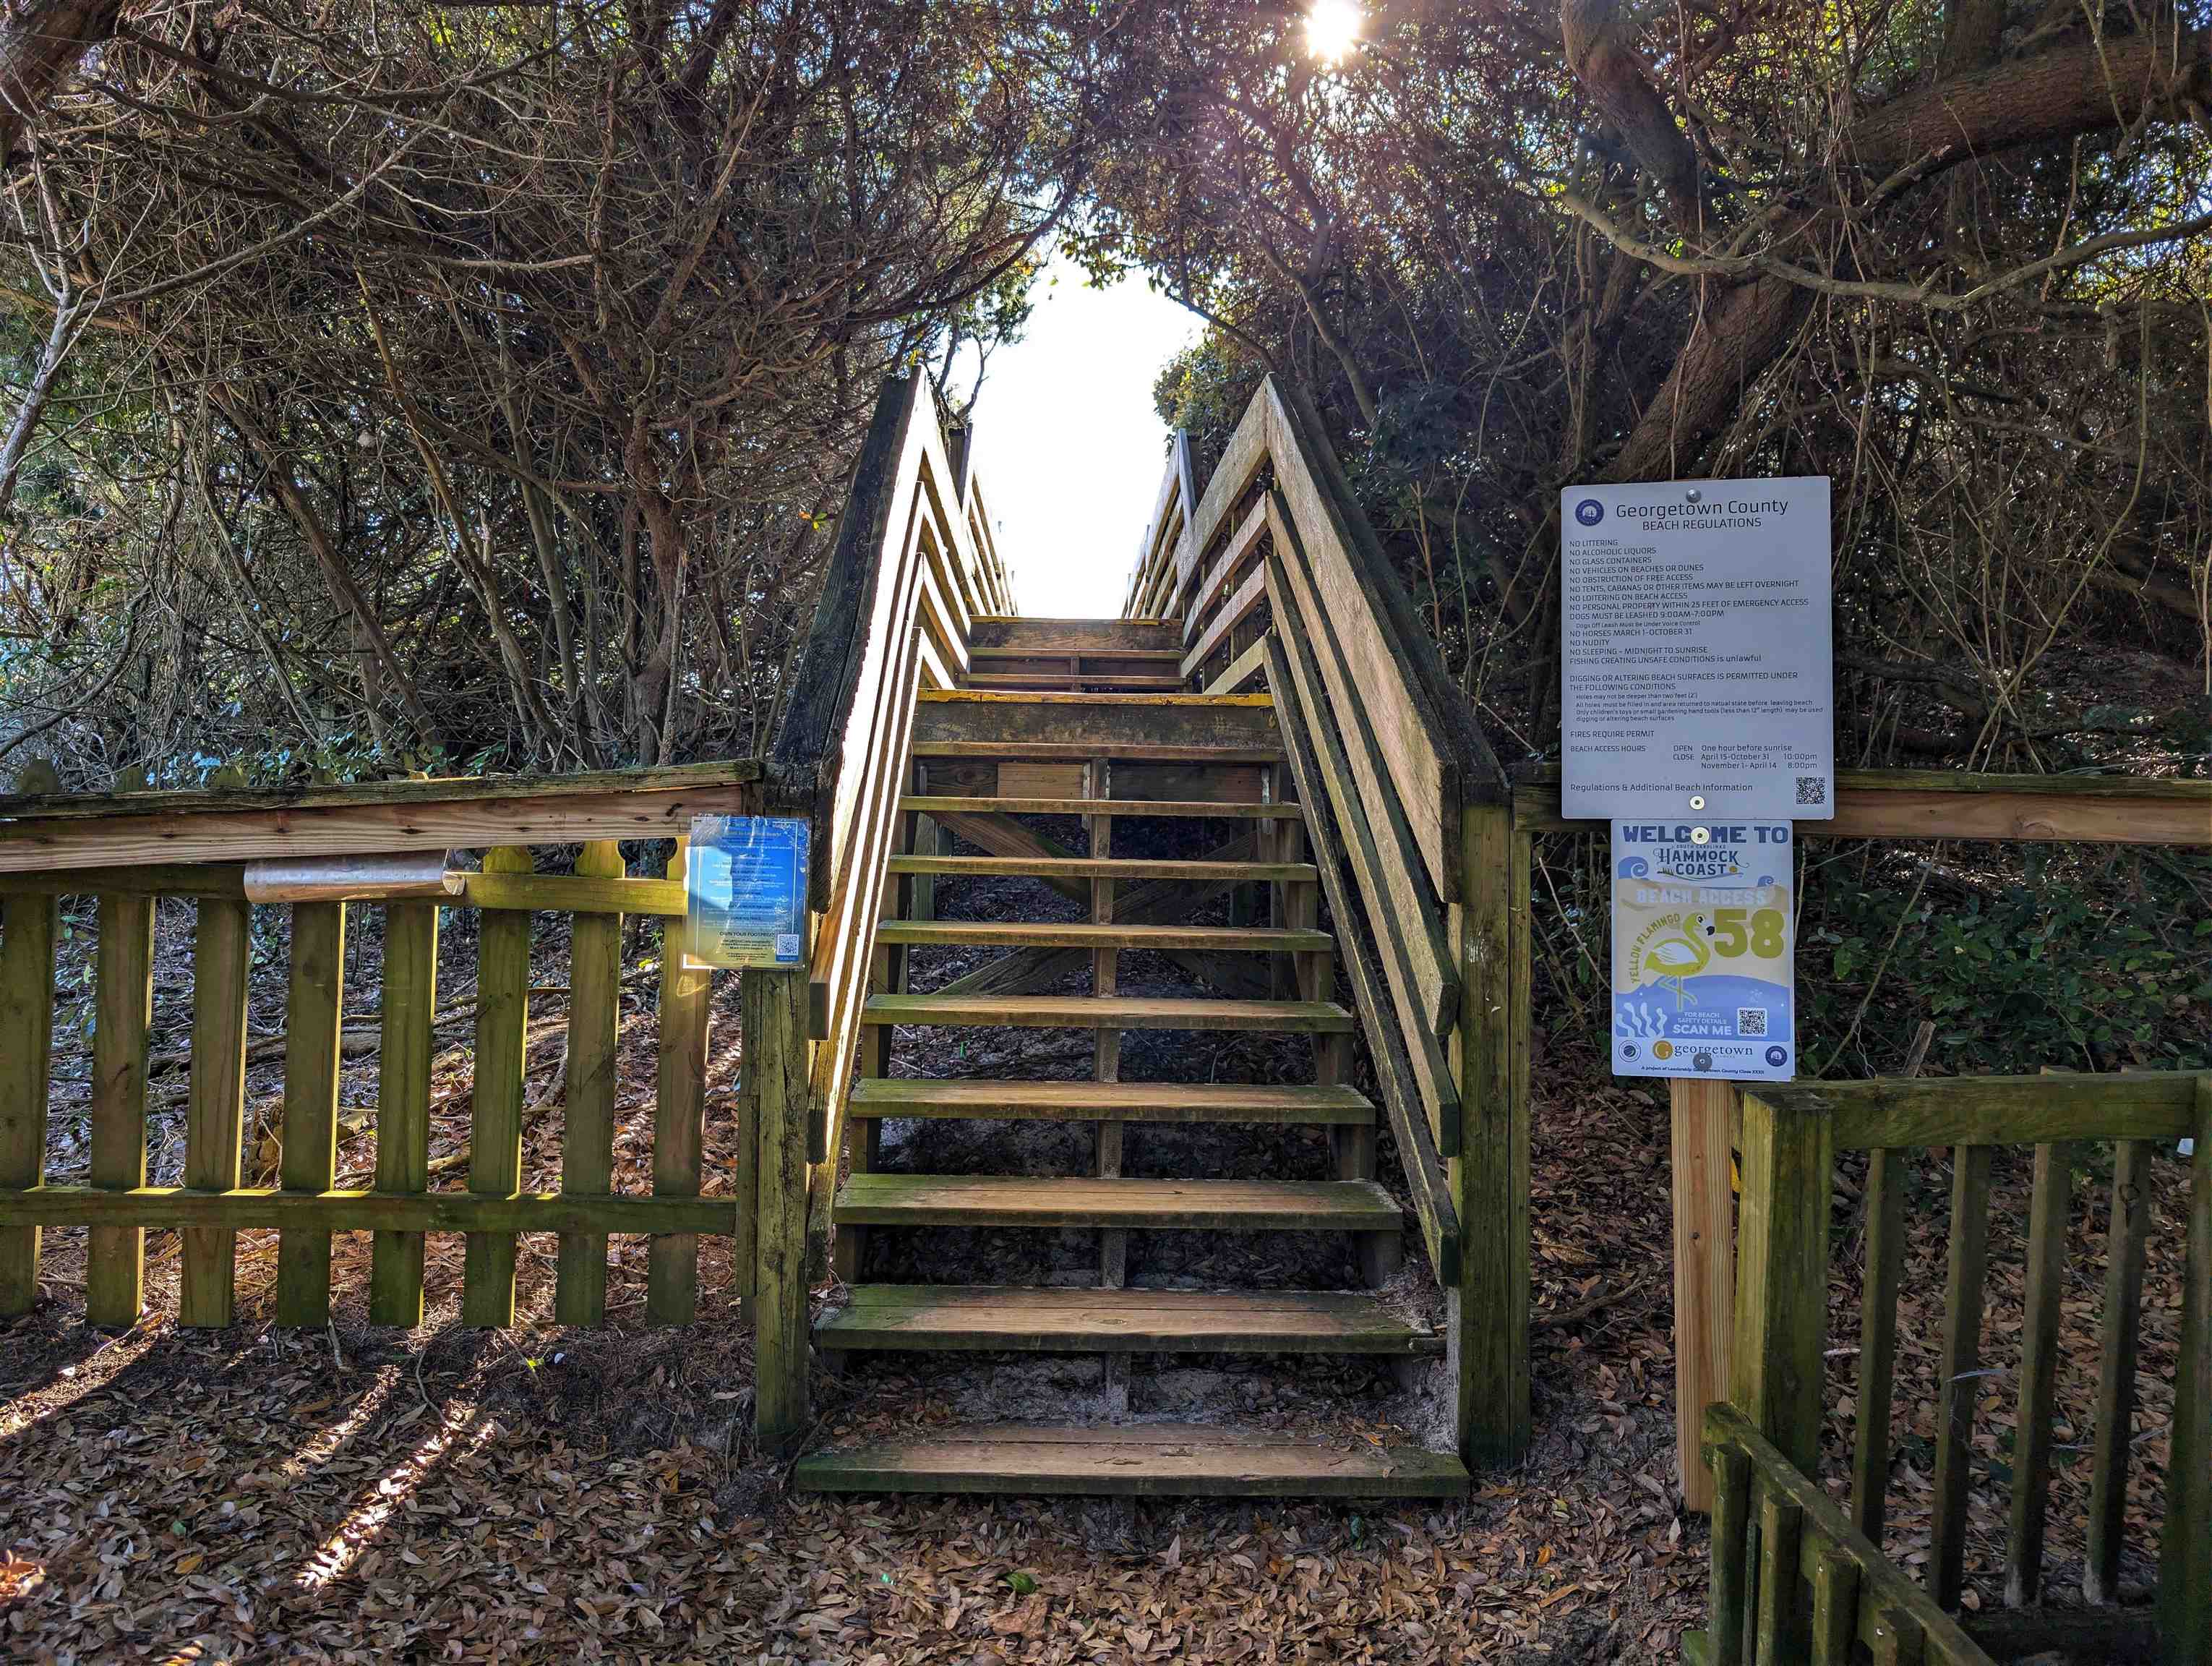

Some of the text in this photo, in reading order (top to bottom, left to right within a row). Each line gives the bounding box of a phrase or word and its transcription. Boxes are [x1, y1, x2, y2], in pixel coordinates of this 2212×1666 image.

[1616, 503, 1722, 519] Georgetown
[1728, 499, 1788, 516] County
[1642, 518, 1762, 531] BEACH REGULATIONS
[1570, 784, 1620, 793] Regulations
[1623, 826, 1789, 844] WELCME TO
[1657, 848, 1744, 866] HAMMOCK
[1676, 863, 1727, 875] COAST
[1636, 889, 1768, 905] BEACH ACCESS
[1637, 913, 1680, 944] FLAMINGO
[1714, 909, 1784, 959] 58
[1673, 1024, 1732, 1035] SCAN ME
[1674, 1044, 1753, 1057] georgetown
